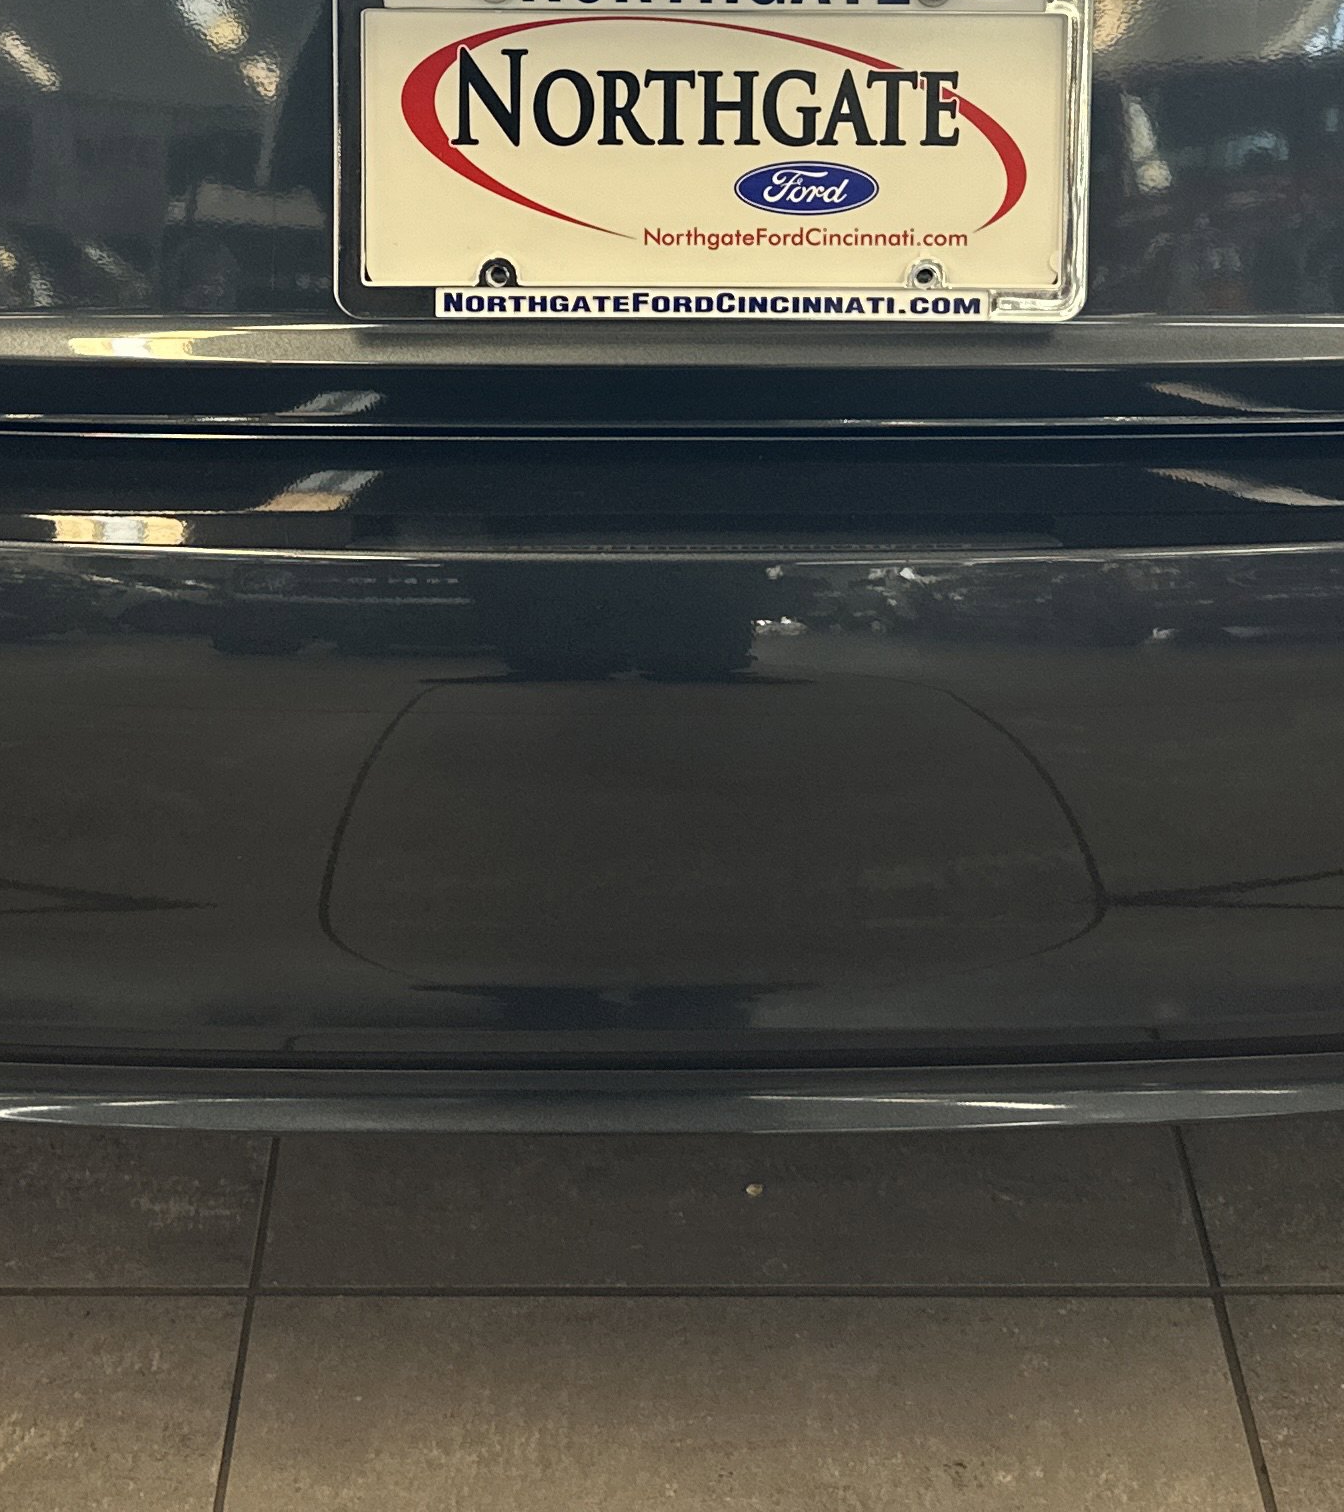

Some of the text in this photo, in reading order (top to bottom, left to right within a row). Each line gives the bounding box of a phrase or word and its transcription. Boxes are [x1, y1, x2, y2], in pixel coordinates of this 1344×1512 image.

[451, 48, 960, 147] NORTHGATE
[762, 169, 850, 203] Ford
[644, 227, 969, 249] NorthgateFordCincinnati.com
[442, 291, 982, 316] NORTHGATEFORDCINCINNATI.COM
